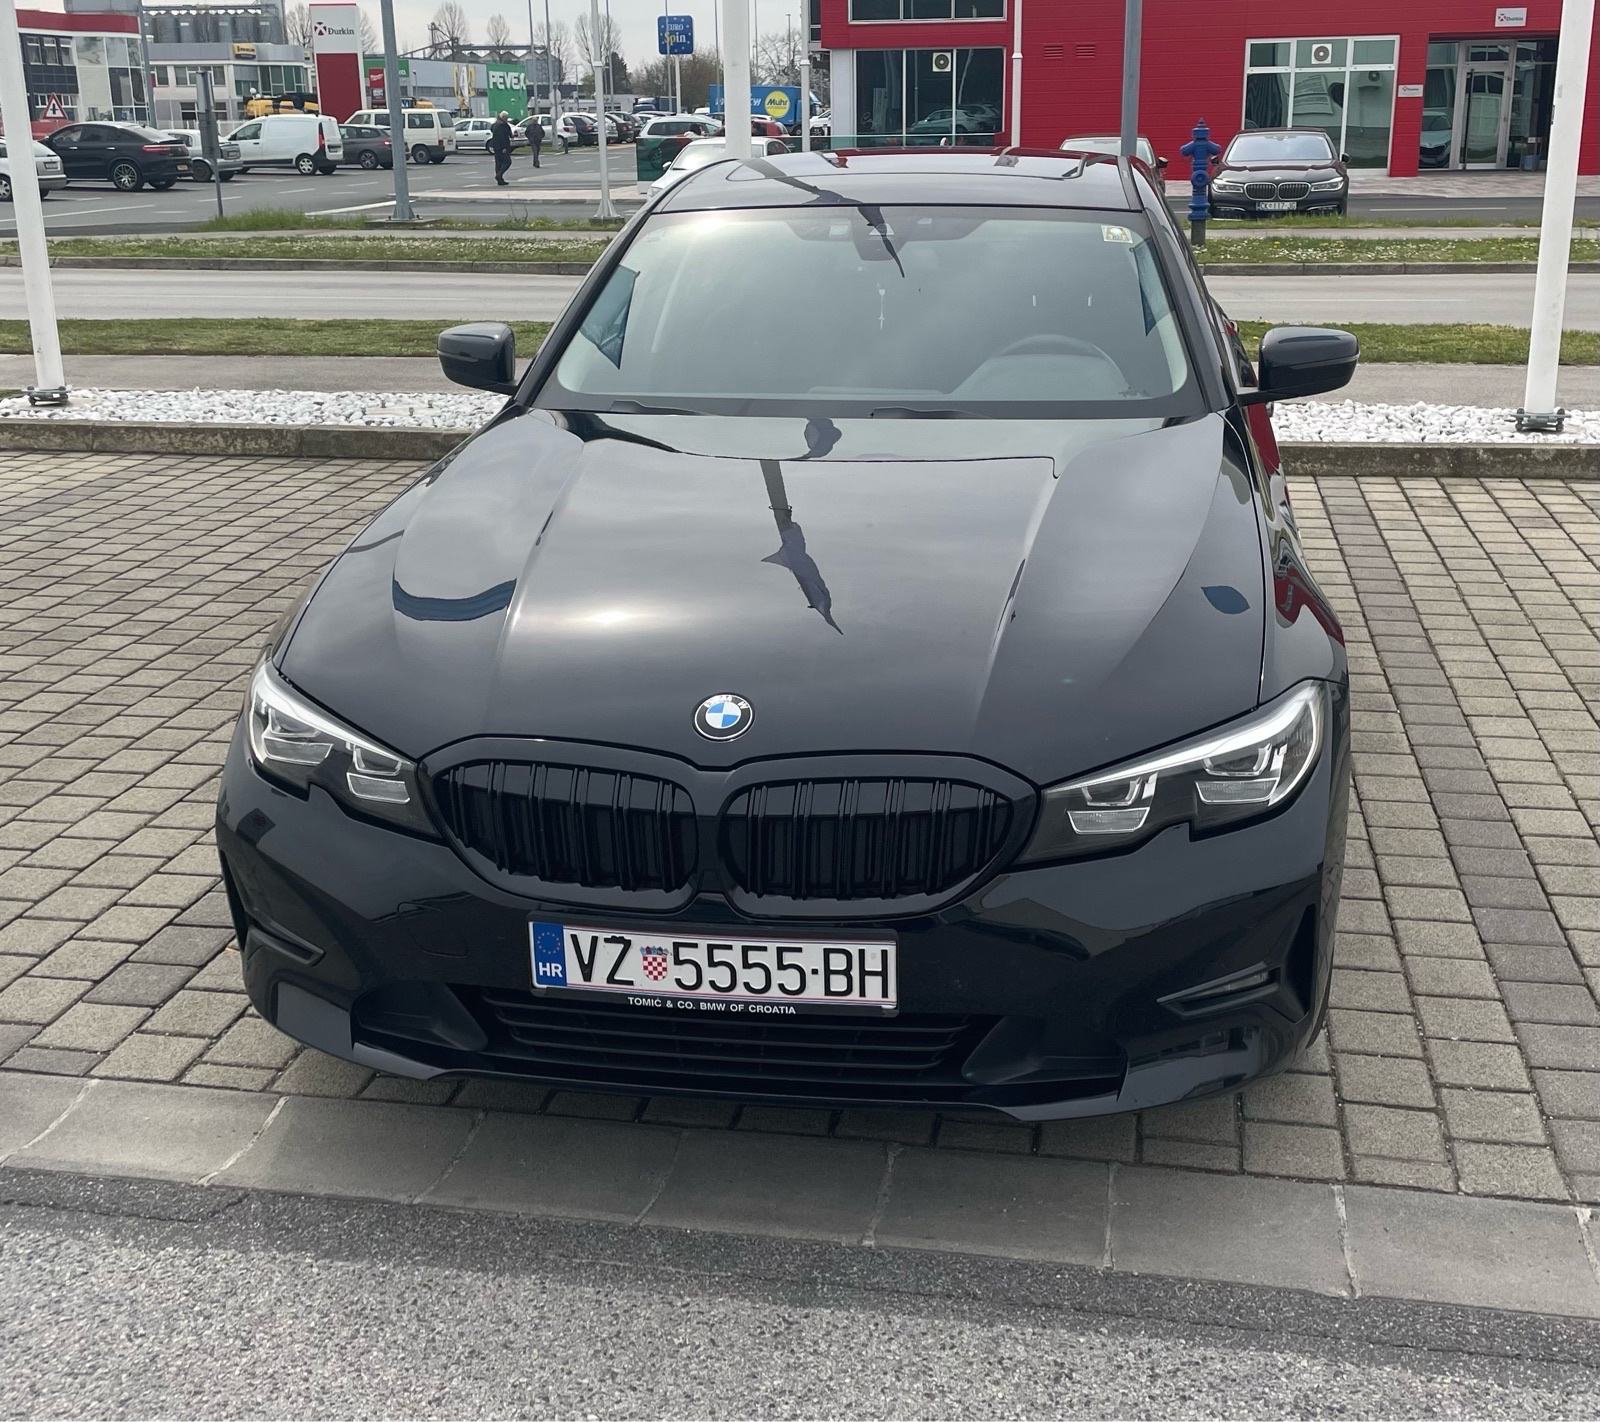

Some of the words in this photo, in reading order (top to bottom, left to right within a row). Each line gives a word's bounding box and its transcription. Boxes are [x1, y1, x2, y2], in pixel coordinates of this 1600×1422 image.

[328, 27, 355, 35] Durkin
[488, 71, 527, 90] PEVEX
[538, 962, 564, 978] HR
[666, 1000, 674, 1009] &
[677, 1000, 697, 1010] CO.
[700, 1002, 726, 1012] BMW
[730, 1004, 745, 1013] OF
[748, 1005, 797, 1015] CROATIA
